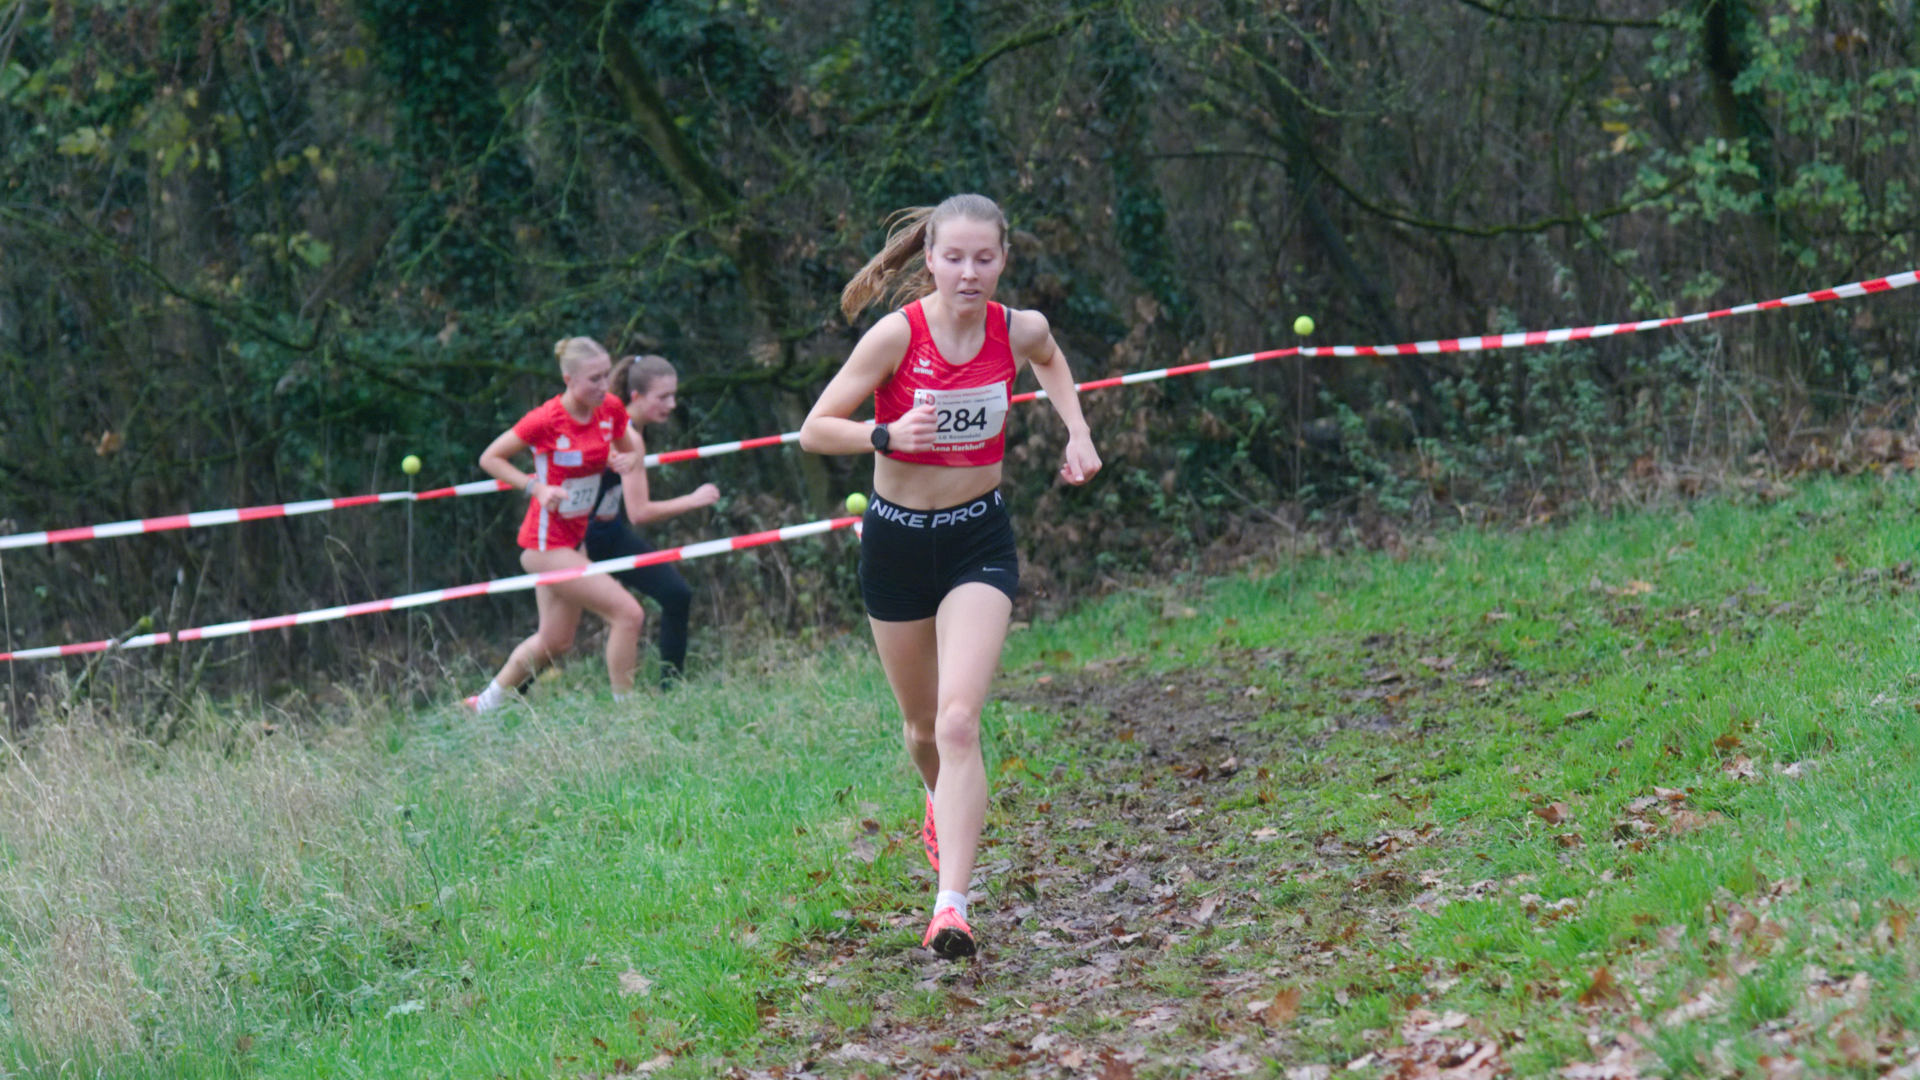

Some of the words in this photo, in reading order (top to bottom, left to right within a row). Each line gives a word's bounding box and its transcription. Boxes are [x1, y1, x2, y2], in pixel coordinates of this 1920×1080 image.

[936, 406, 987, 433] 284
[871, 498, 928, 529] NIKE
[931, 500, 988, 529] PRO
